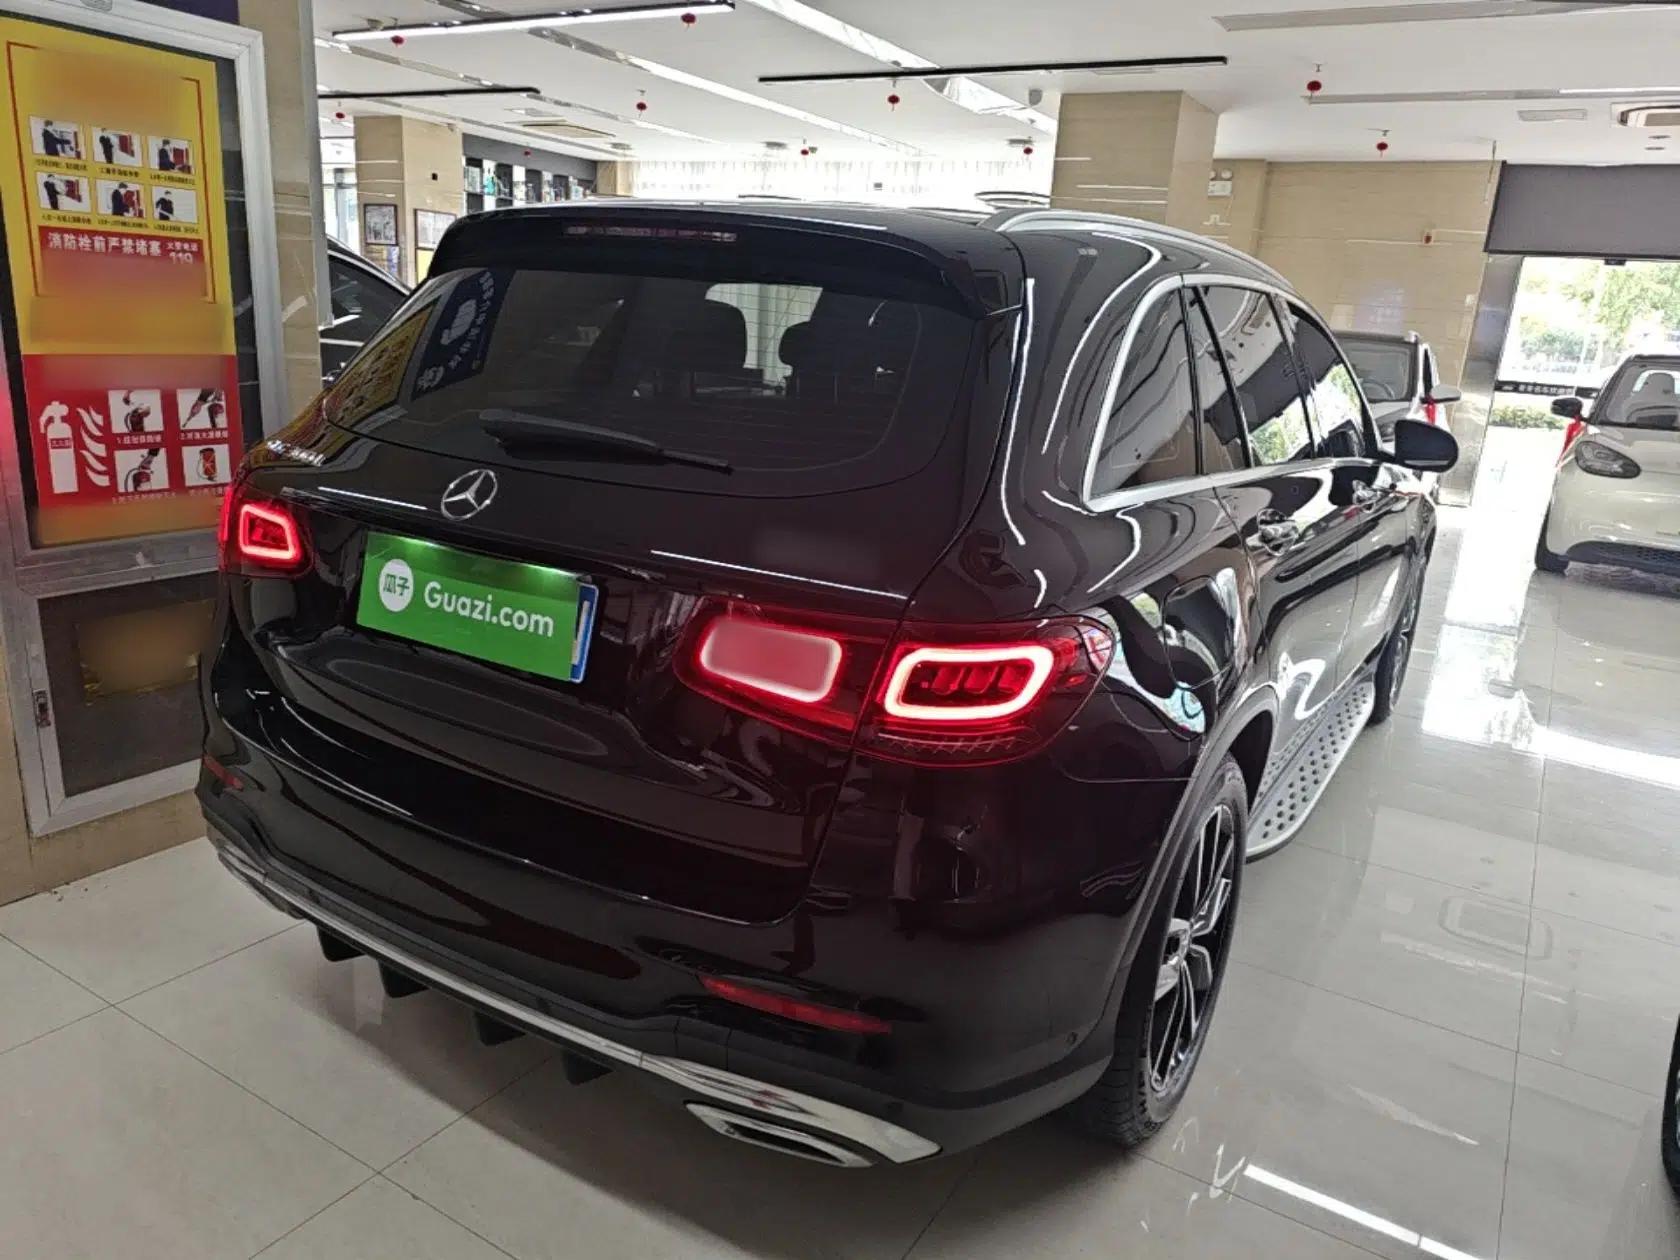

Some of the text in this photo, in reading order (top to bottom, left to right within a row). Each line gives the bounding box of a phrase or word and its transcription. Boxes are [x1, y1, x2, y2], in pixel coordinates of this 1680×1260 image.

[48, 231, 162, 258] 消防栓前严禁堵塞
[169, 251, 194, 265] 119
[382, 572, 411, 597] 瓜子
[424, 580, 554, 638] Guazi.com
